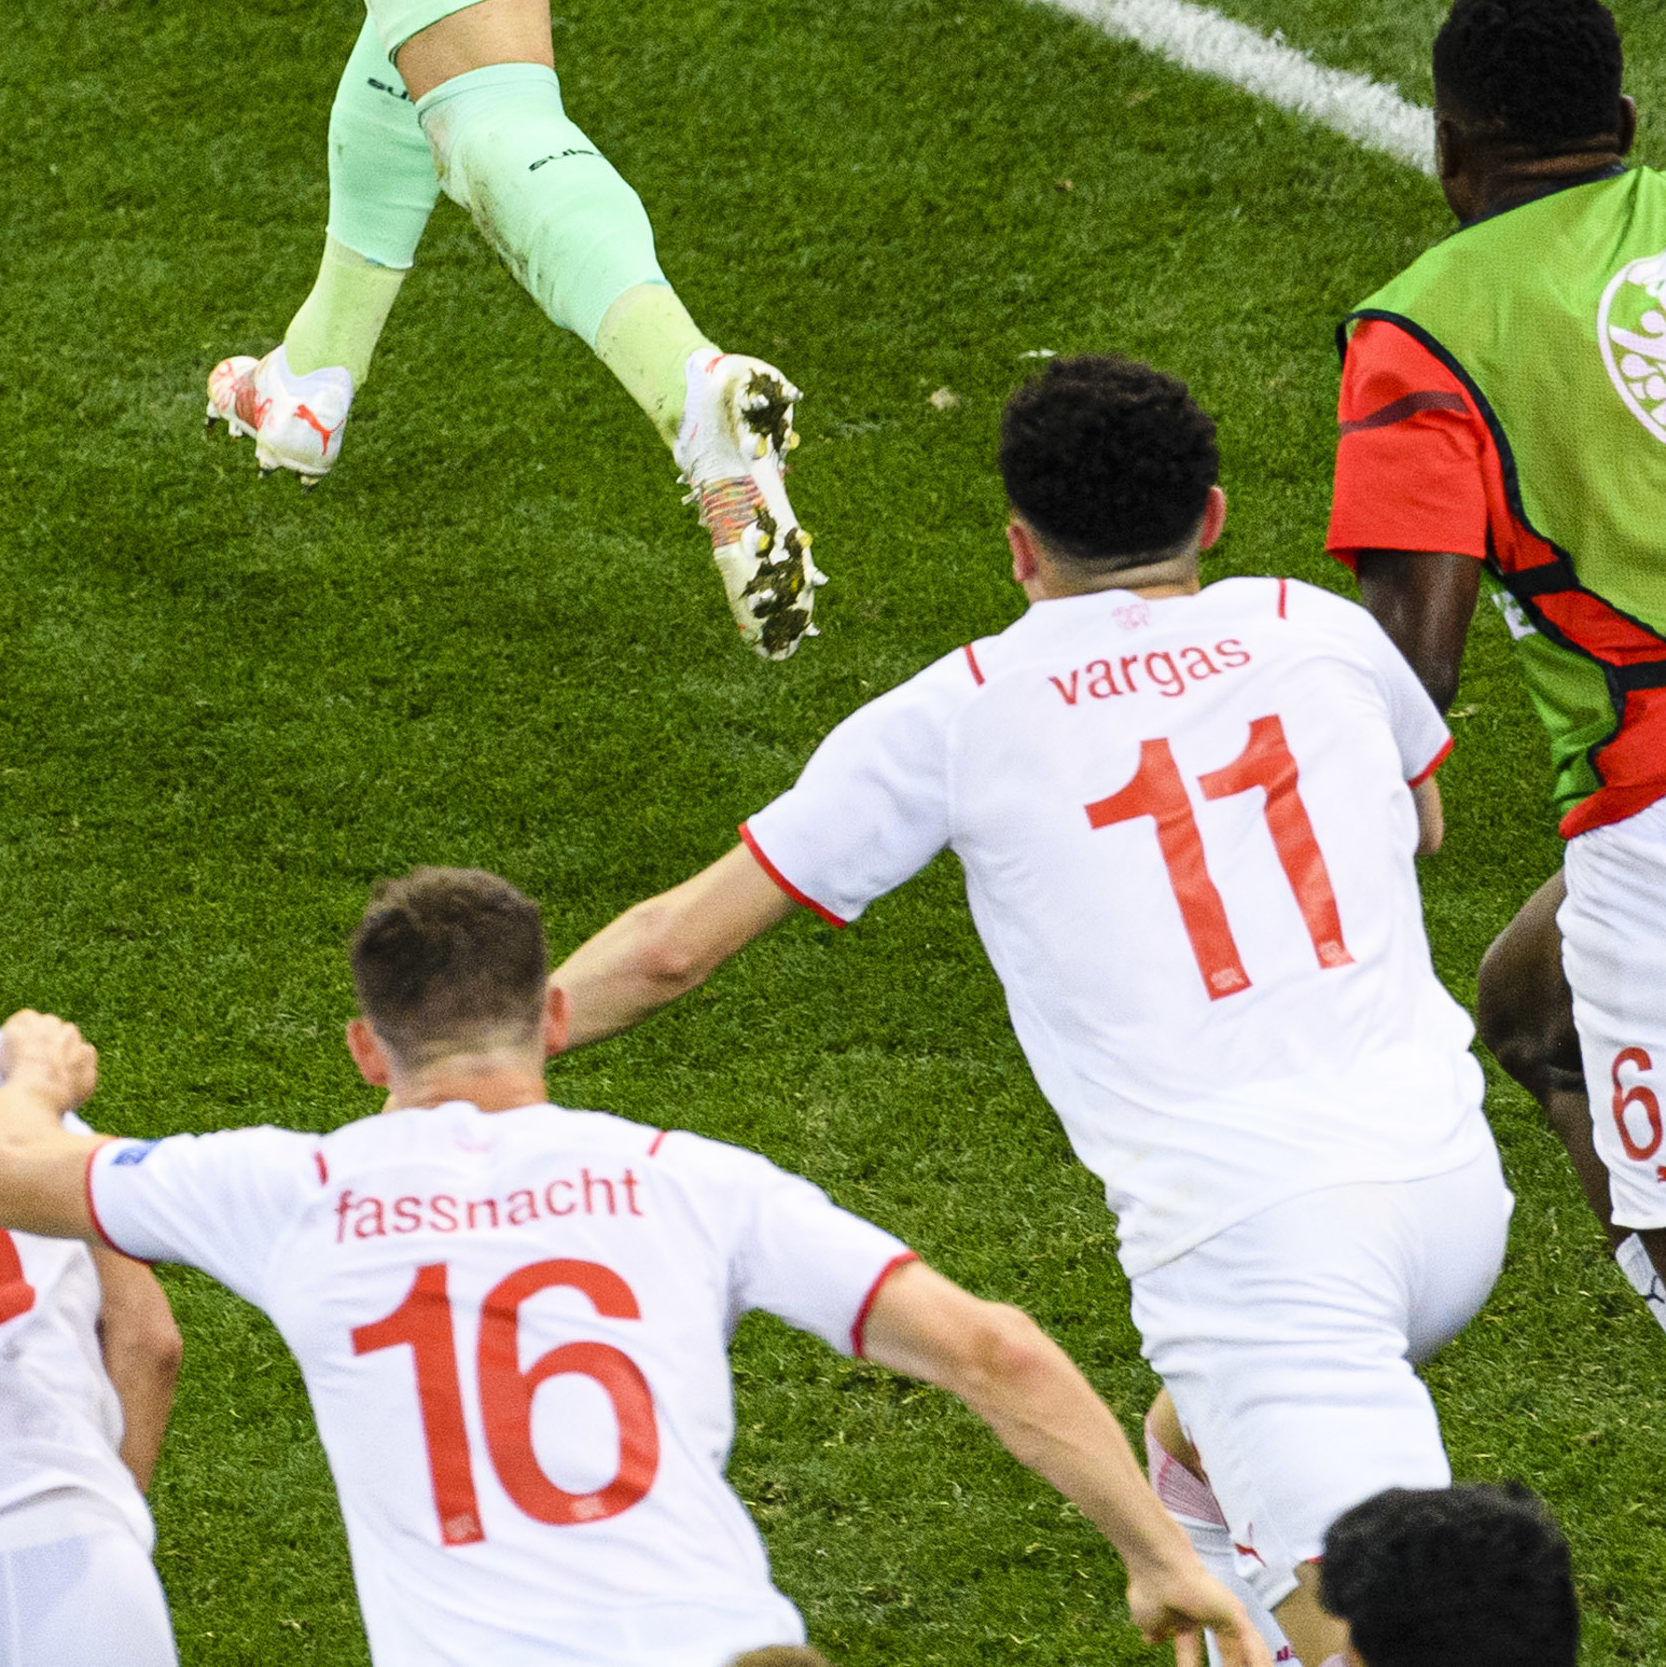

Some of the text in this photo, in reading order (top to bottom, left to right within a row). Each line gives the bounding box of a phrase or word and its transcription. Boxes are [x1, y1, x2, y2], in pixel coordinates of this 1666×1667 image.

[1047, 638, 1252, 706] vargas
[1083, 713, 1357, 1002] 11
[1611, 1046, 1663, 1162] 6
[334, 1167, 644, 1244] fassnacht
[349, 1258, 660, 1547] 16
